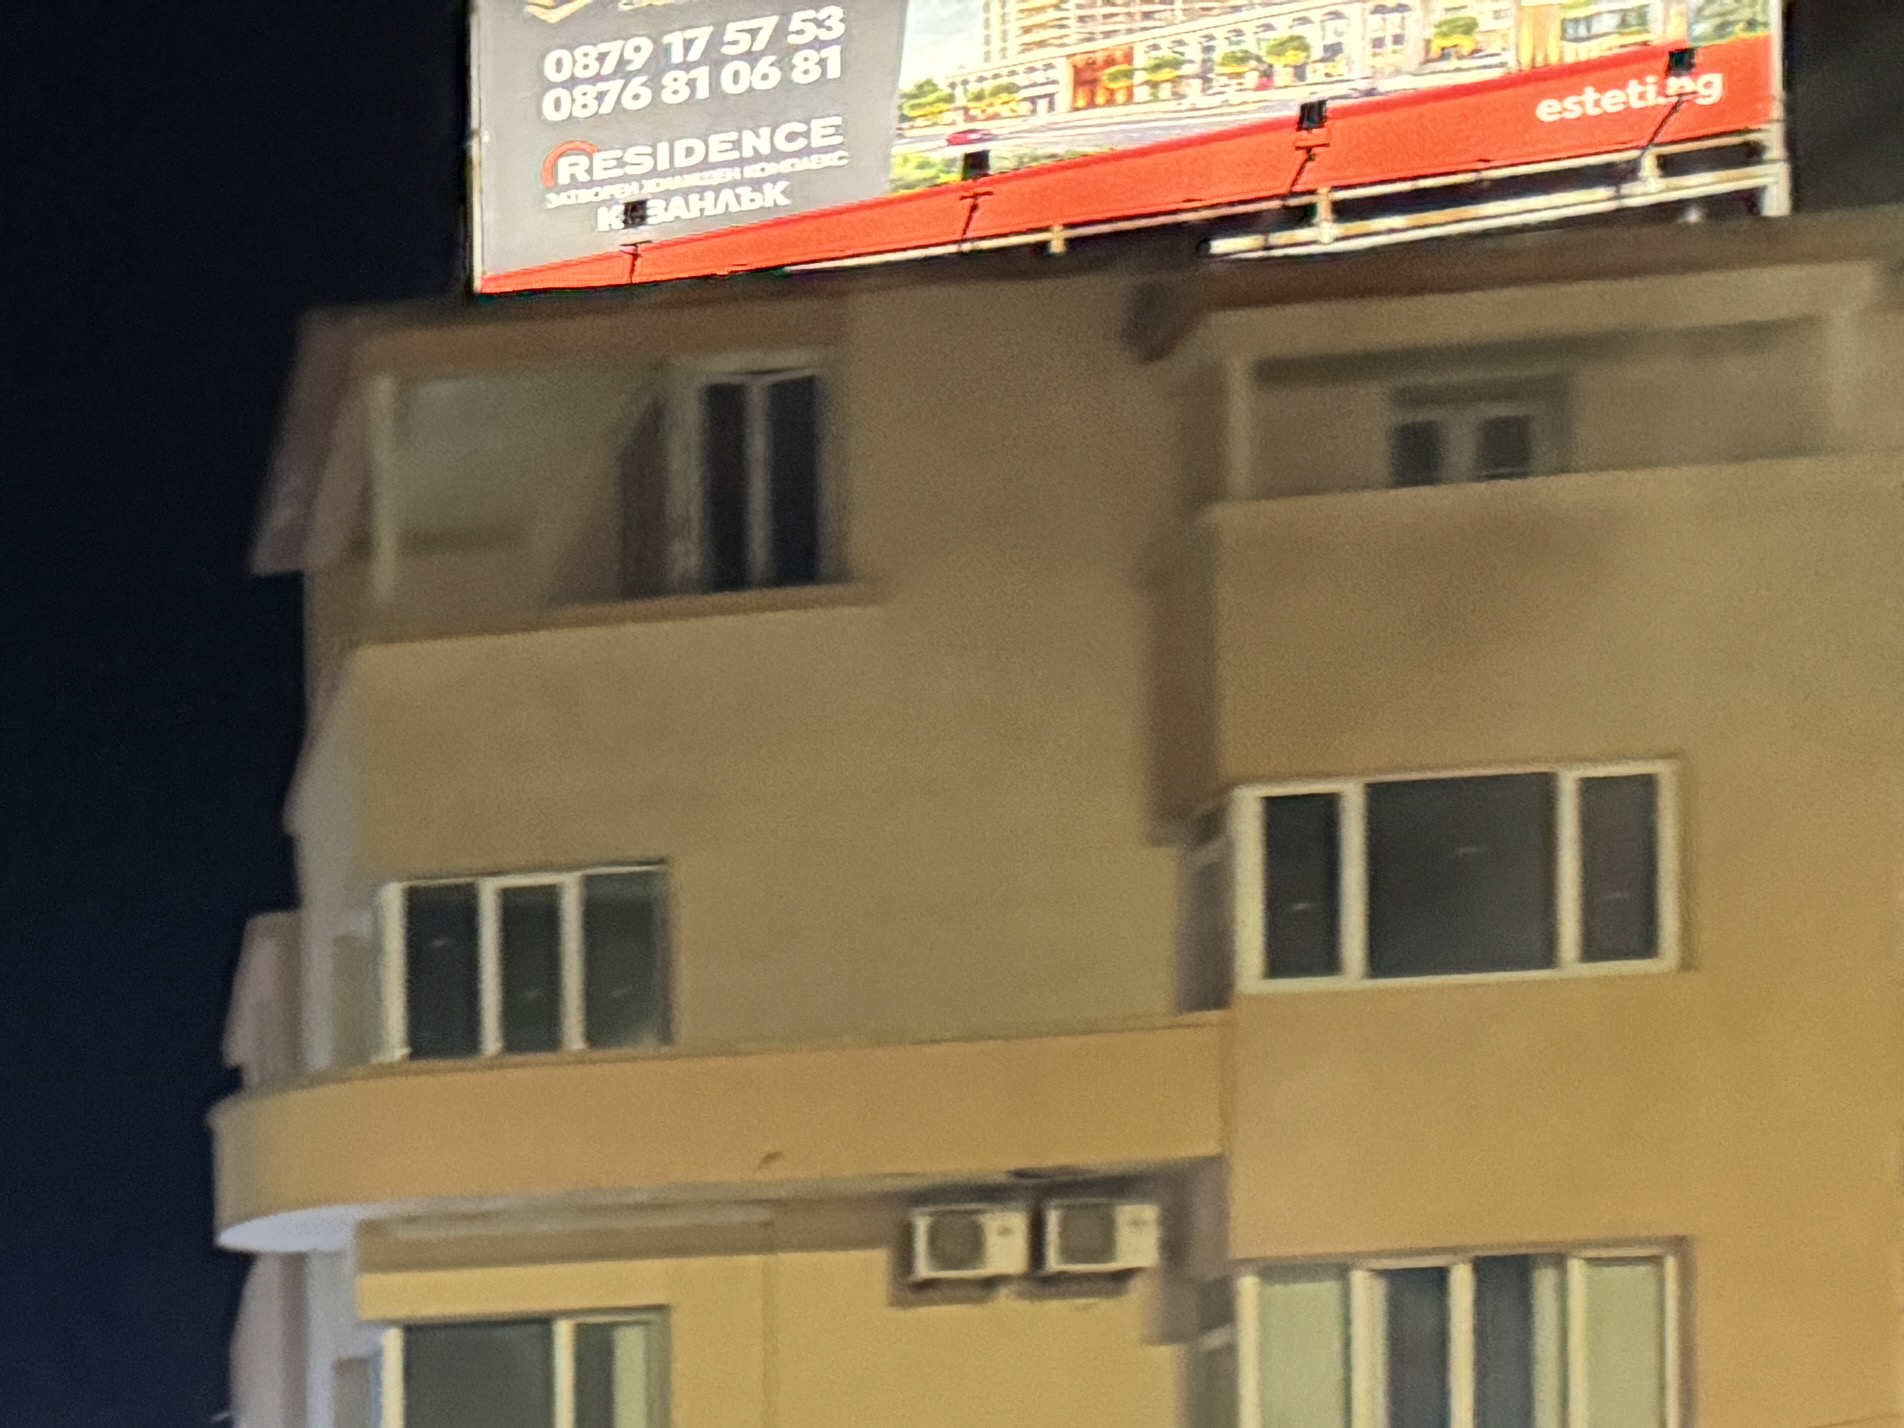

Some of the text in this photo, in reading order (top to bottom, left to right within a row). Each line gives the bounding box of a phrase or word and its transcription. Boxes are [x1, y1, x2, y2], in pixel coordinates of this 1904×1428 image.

[544, 6, 845, 83] 0879 17 57 53
[542, 45, 842, 122] 0876 81 06 81
[557, 116, 845, 185] RESIDENCE
[597, 180, 791, 232] КЗАНЛЪК
